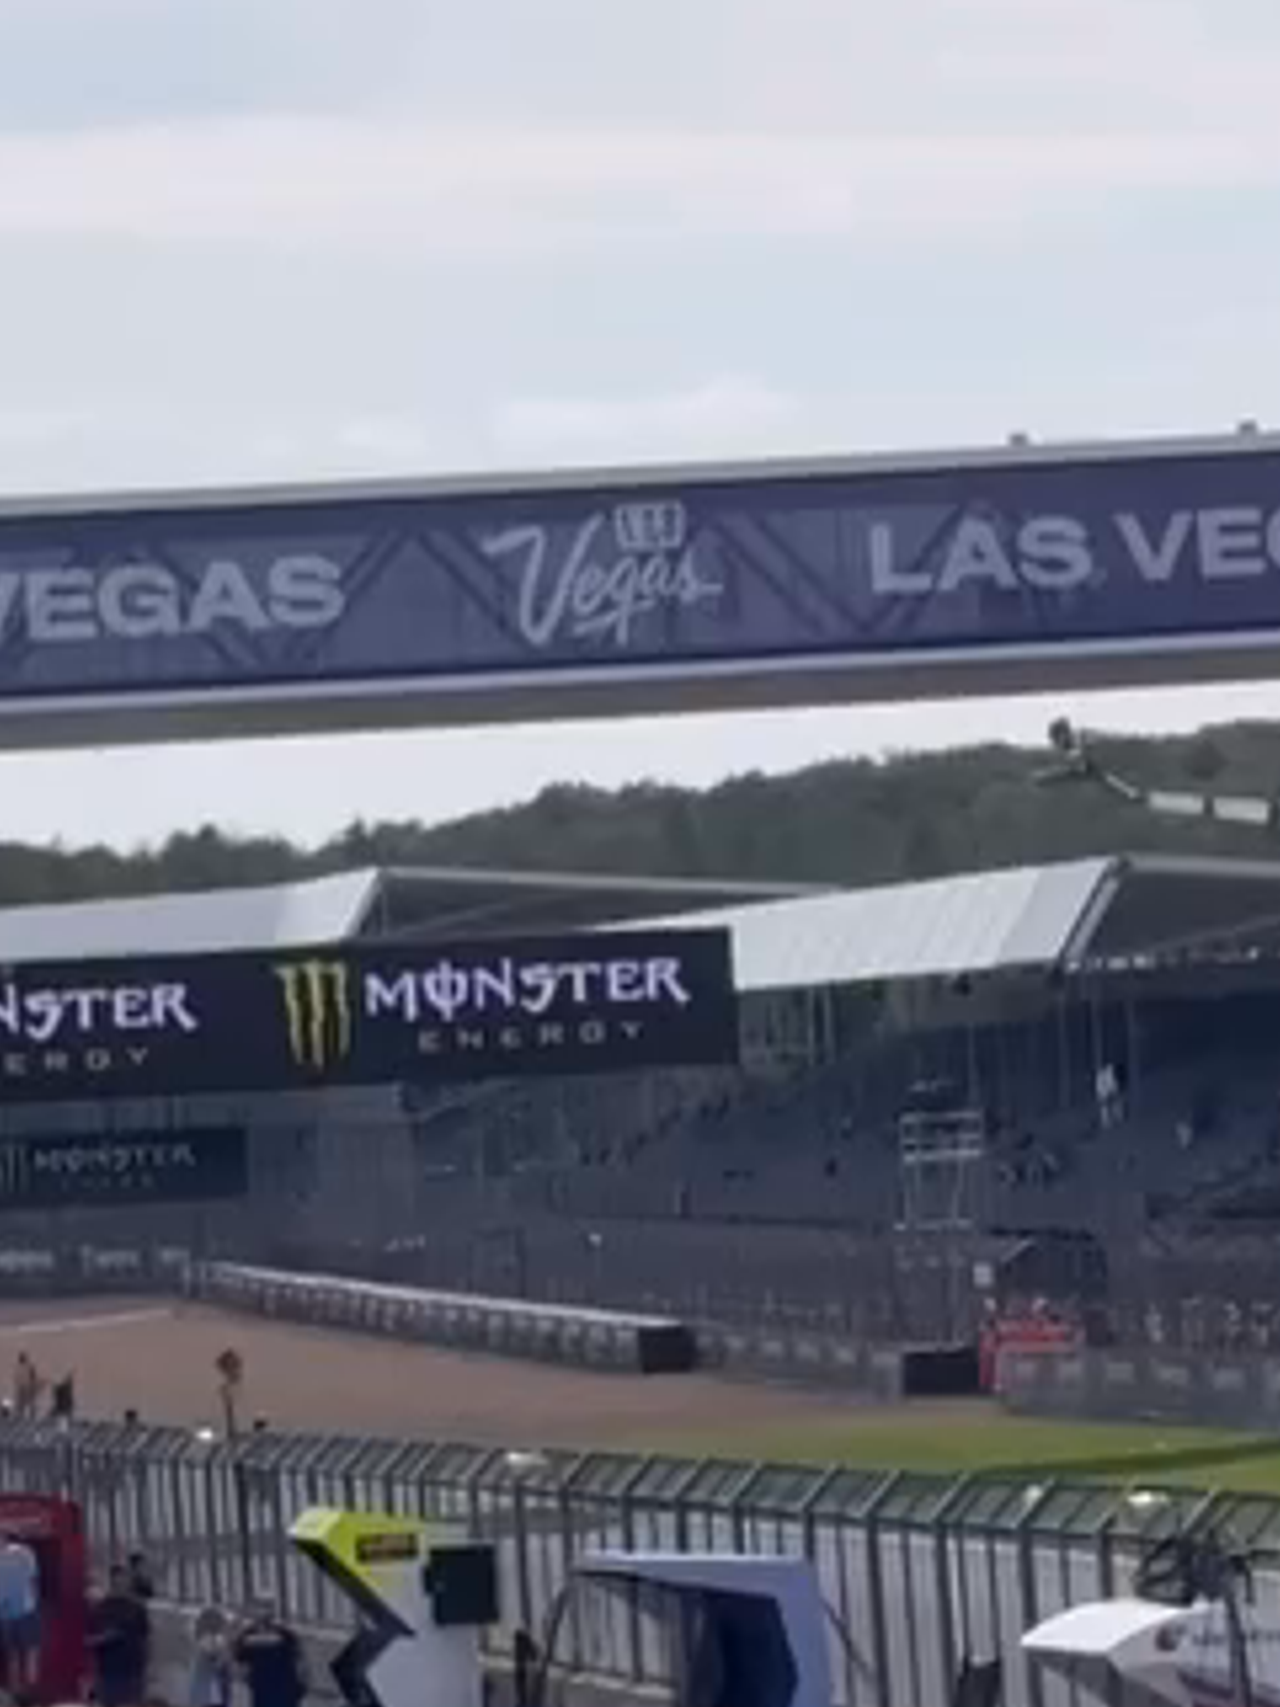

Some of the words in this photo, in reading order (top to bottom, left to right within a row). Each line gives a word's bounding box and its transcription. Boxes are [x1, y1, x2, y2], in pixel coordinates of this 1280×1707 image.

[480, 510, 724, 645] Vegas
[870, 512, 1093, 592] LAS
[365, 956, 690, 1022] MONSTER
[419, 1021, 643, 1051] ENERGY
